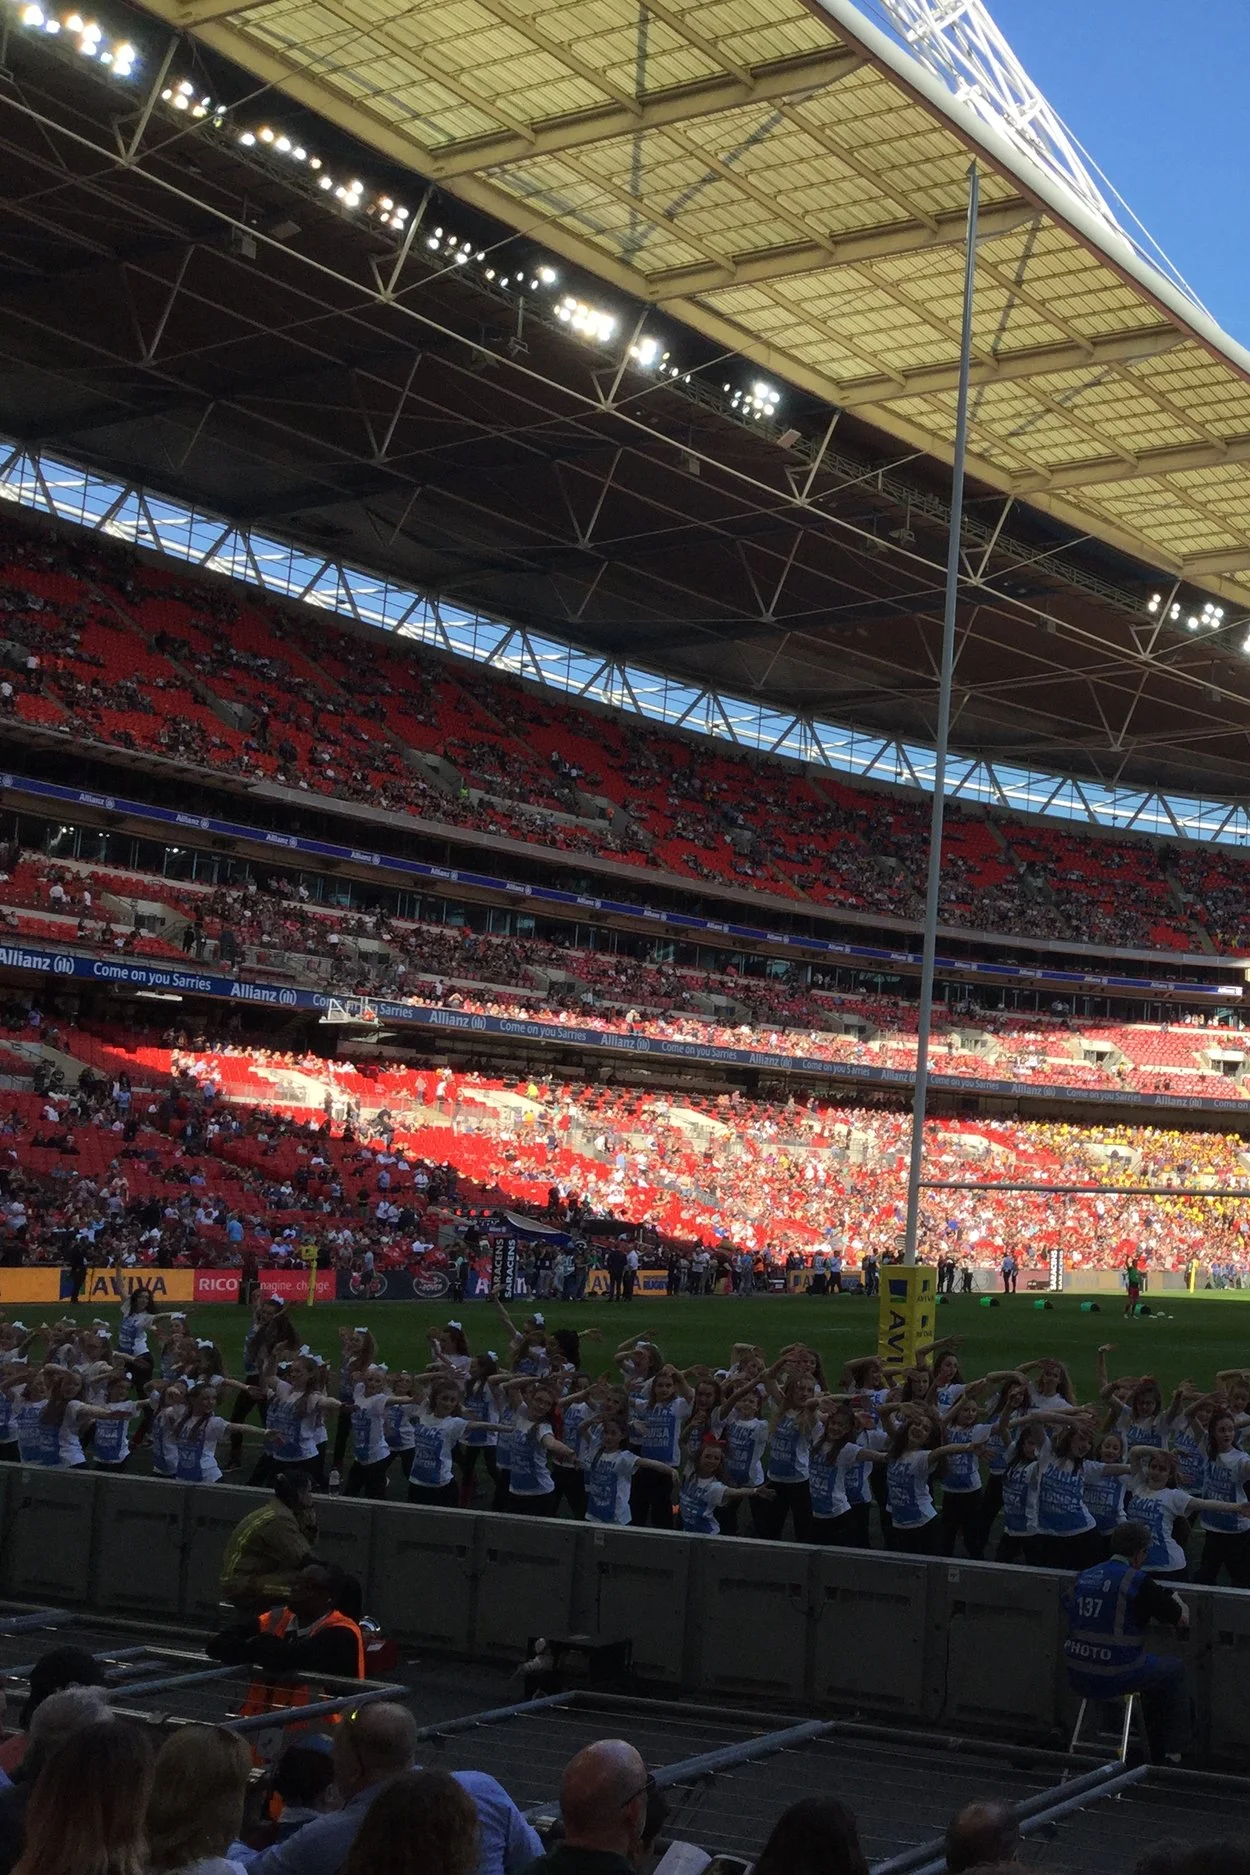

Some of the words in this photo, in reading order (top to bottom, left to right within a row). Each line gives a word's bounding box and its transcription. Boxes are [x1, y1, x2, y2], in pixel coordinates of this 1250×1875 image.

[79, 793, 104, 805] Allianz
[94, 962, 128, 979] Come
[130, 970, 146, 981] on
[148, 971, 170, 986] you
[172, 973, 212, 991] Sarries
[230, 983, 276, 1002] Allianz
[379, 1003, 414, 1018] Sarries
[429, 1010, 469, 1027] Allianz
[500, 1021, 525, 1034] Come
[527, 1026, 539, 1034] on
[540, 1027, 557, 1040] you
[558, 1028, 587, 1041] Sarries
[600, 1034, 636, 1049] Allianz
[661, 1041, 684, 1054] Come
[685, 1046, 696, 1055] on
[697, 1047, 711, 1059] you
[711, 1048, 737, 1061] Sarries
[750, 1052, 780, 1067] Allianz
[802, 1059, 823, 1071] Come
[823, 1064, 832, 1072] on
[833, 1064, 846, 1075] you
[881, 1069, 908, 1082] Allianz
[1011, 1083, 1042, 1096] Allianz
[1067, 1088, 1086, 1098] Come
[1088, 1091, 1099, 1099] on
[1100, 1091, 1115, 1102] you
[1155, 1095, 1188, 1106] Allianz
[1214, 1099, 1236, 1109] Come
[1238, 1102, 1248, 1110] on
[505, 1239, 516, 1298] SARACENS
[93, 1276, 167, 1296] AVIVA
[199, 1278, 242, 1291] RICO
[1077, 1597, 1103, 1617] 137
[1064, 1640, 1111, 1660] PHOTO
